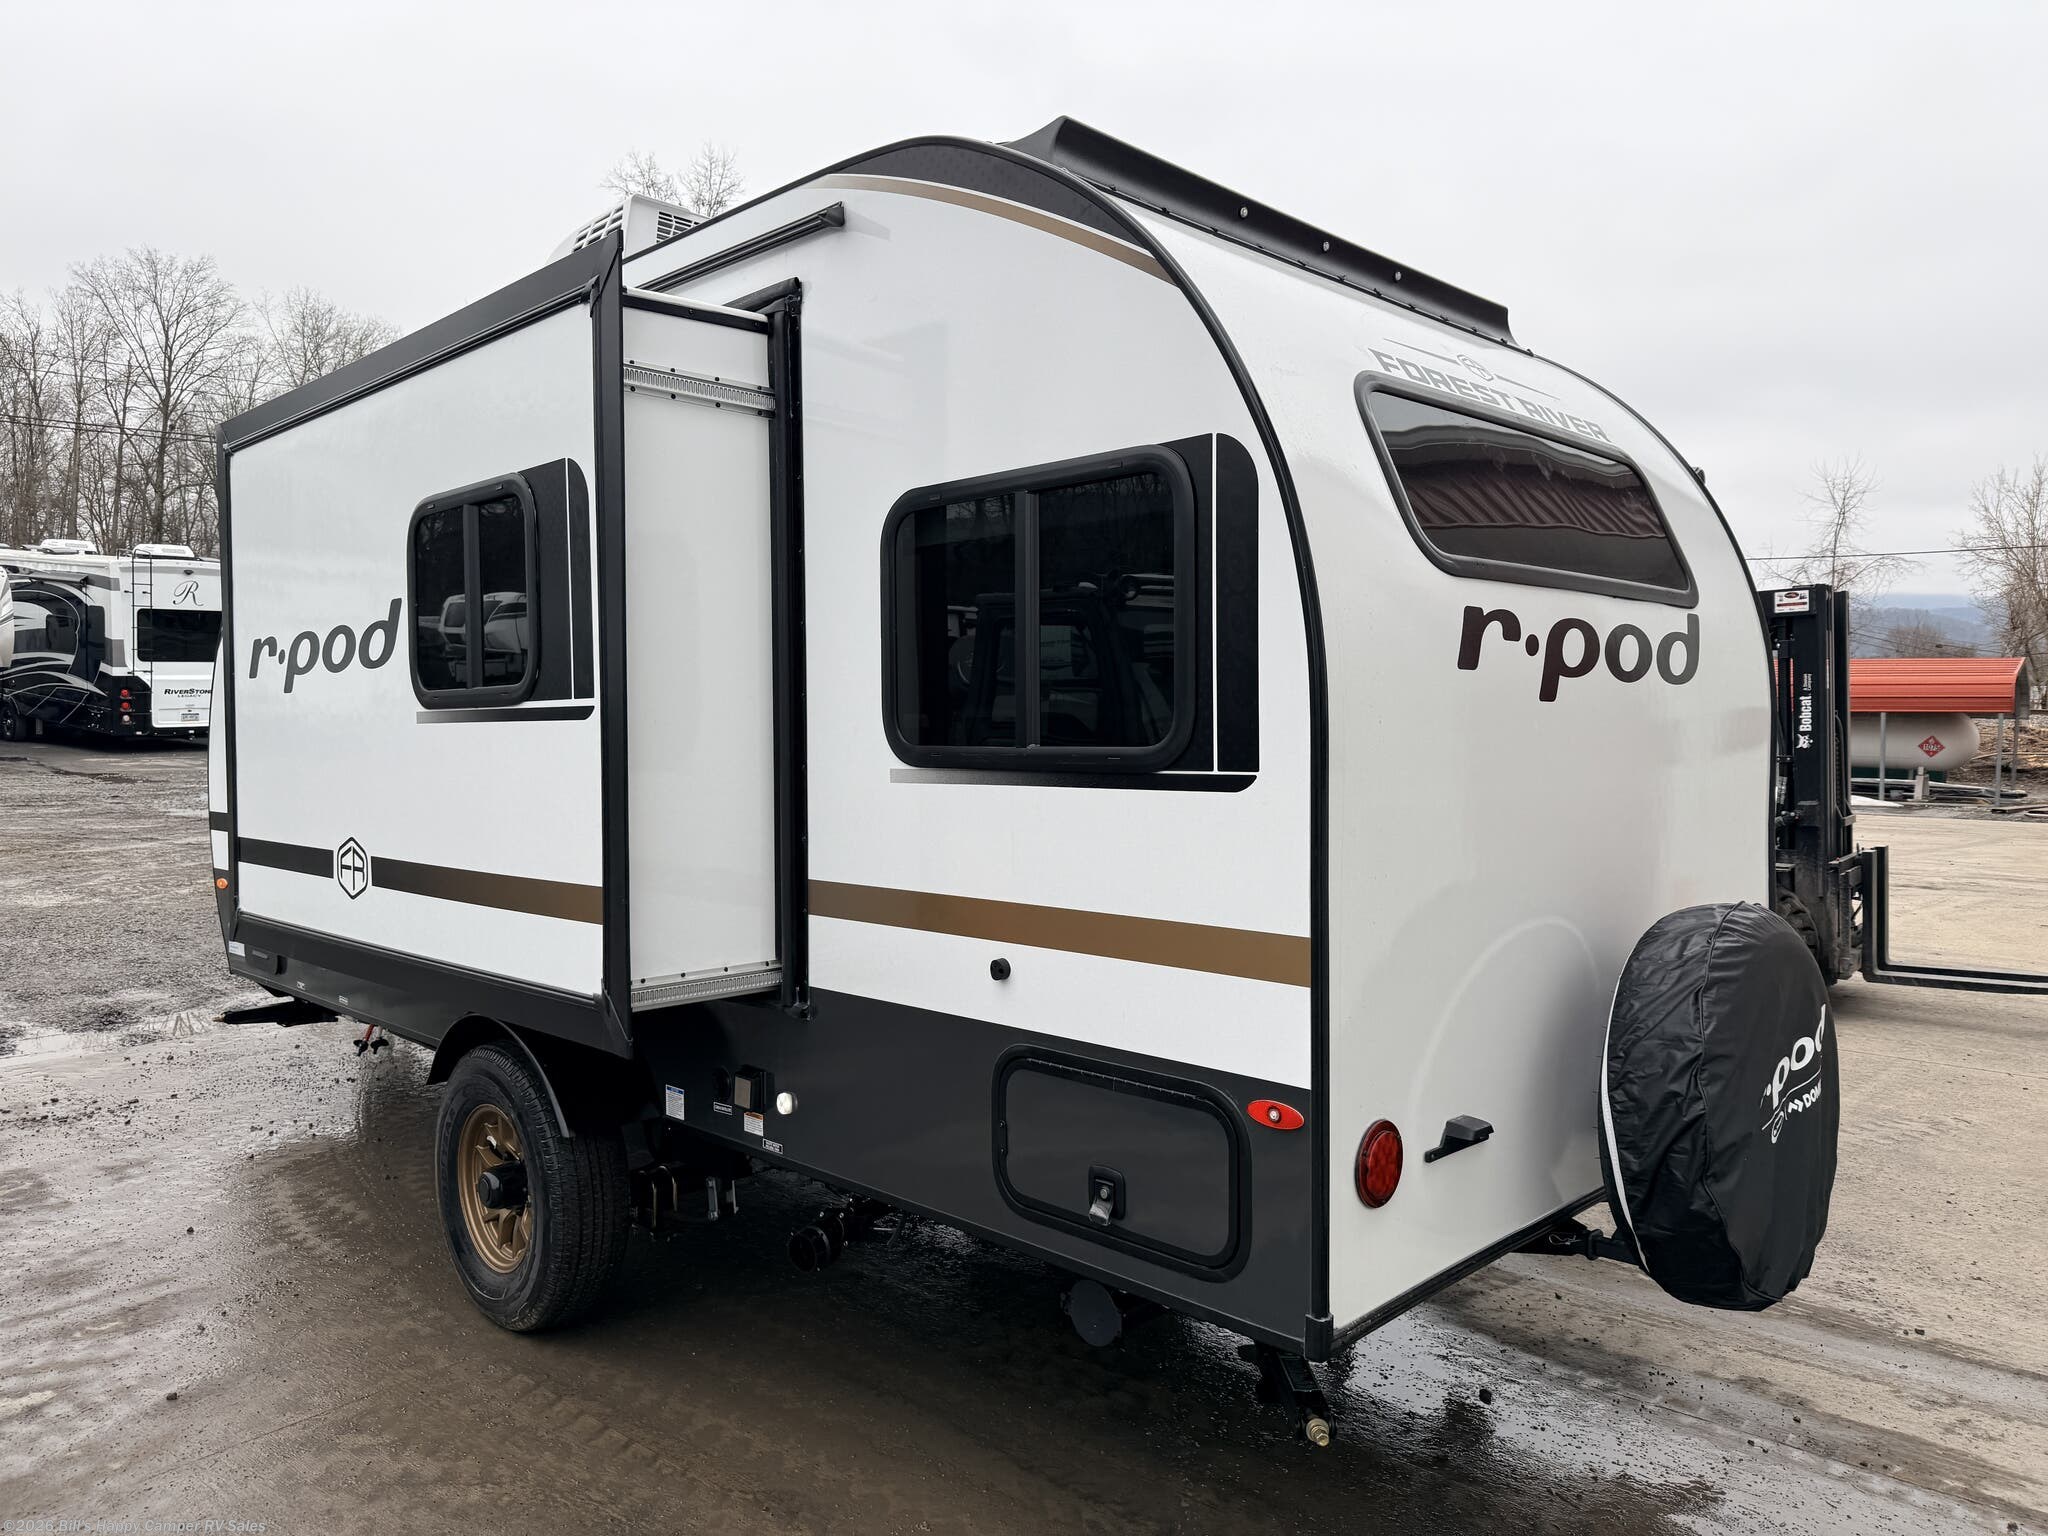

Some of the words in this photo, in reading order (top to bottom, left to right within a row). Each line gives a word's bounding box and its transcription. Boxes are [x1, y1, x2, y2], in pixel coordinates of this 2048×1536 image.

[1367, 348, 1515, 411] FOREST
[1514, 397, 1612, 442] RIVER
[173, 580, 204, 606] R
[1798, 695, 1812, 732] Bobcat
